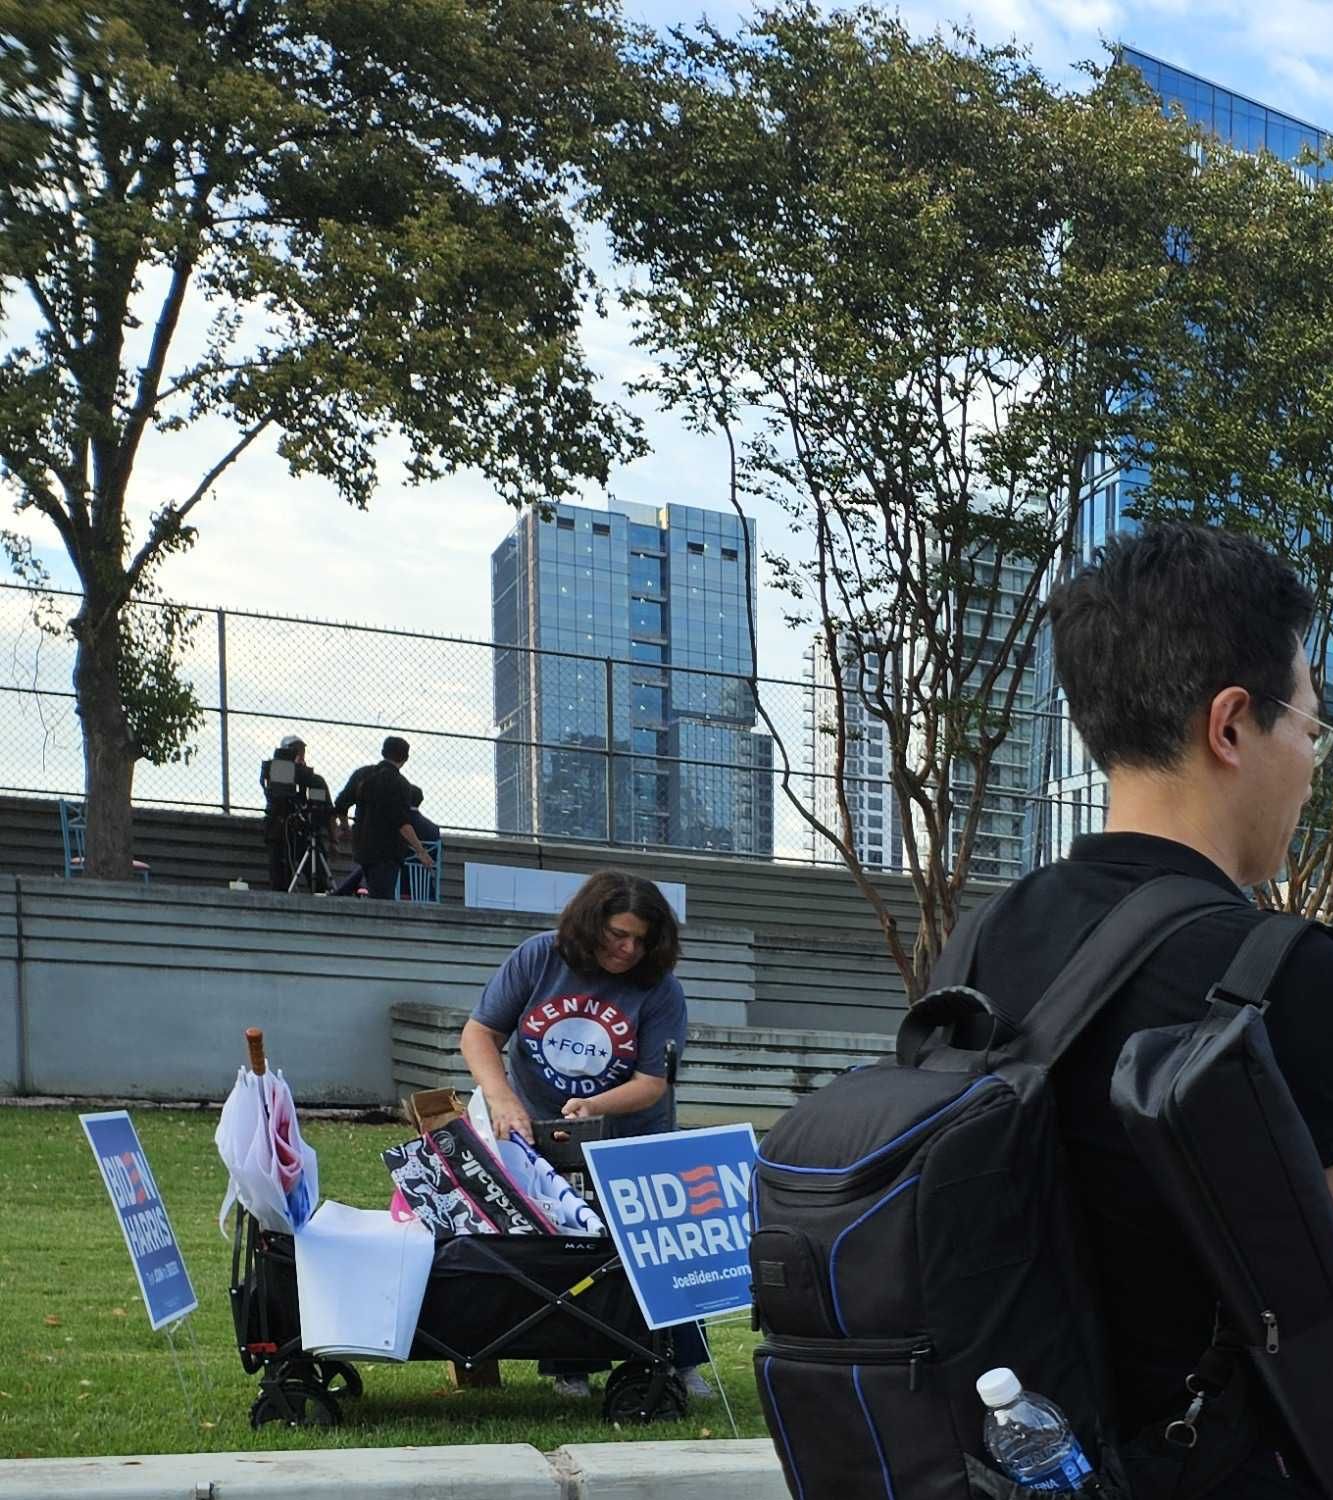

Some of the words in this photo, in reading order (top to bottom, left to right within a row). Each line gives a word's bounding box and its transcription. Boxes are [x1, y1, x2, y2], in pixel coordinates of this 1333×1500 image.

[526, 998, 635, 1052] KENNEDY
[560, 1039, 596, 1057] FOR
[102, 1151, 157, 1208] BIDEN
[609, 1161, 751, 1226] BIDEN
[125, 1205, 172, 1259] HARRIS
[672, 1264, 752, 1289] JoeBiden.com
